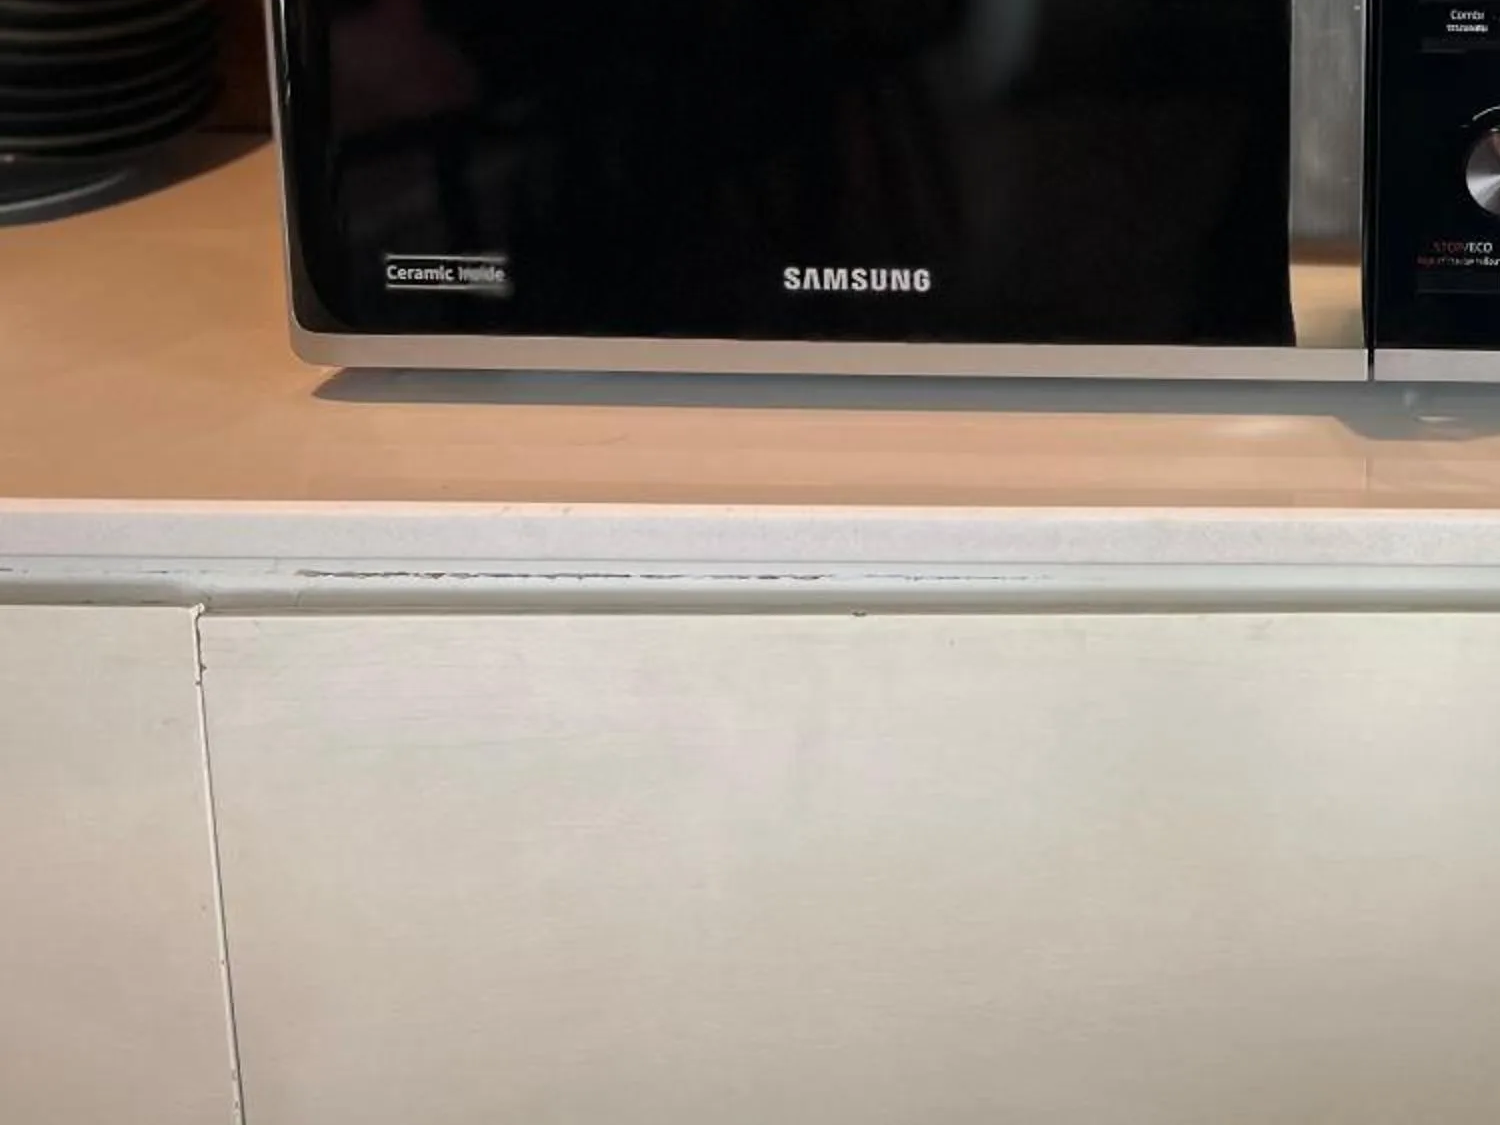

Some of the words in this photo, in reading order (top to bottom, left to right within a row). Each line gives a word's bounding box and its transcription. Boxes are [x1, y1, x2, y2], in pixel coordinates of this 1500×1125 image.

[1450, 9, 1485, 21] Combi
[386, 264, 455, 281] Ceramic
[784, 266, 930, 292] SAMSUNG
